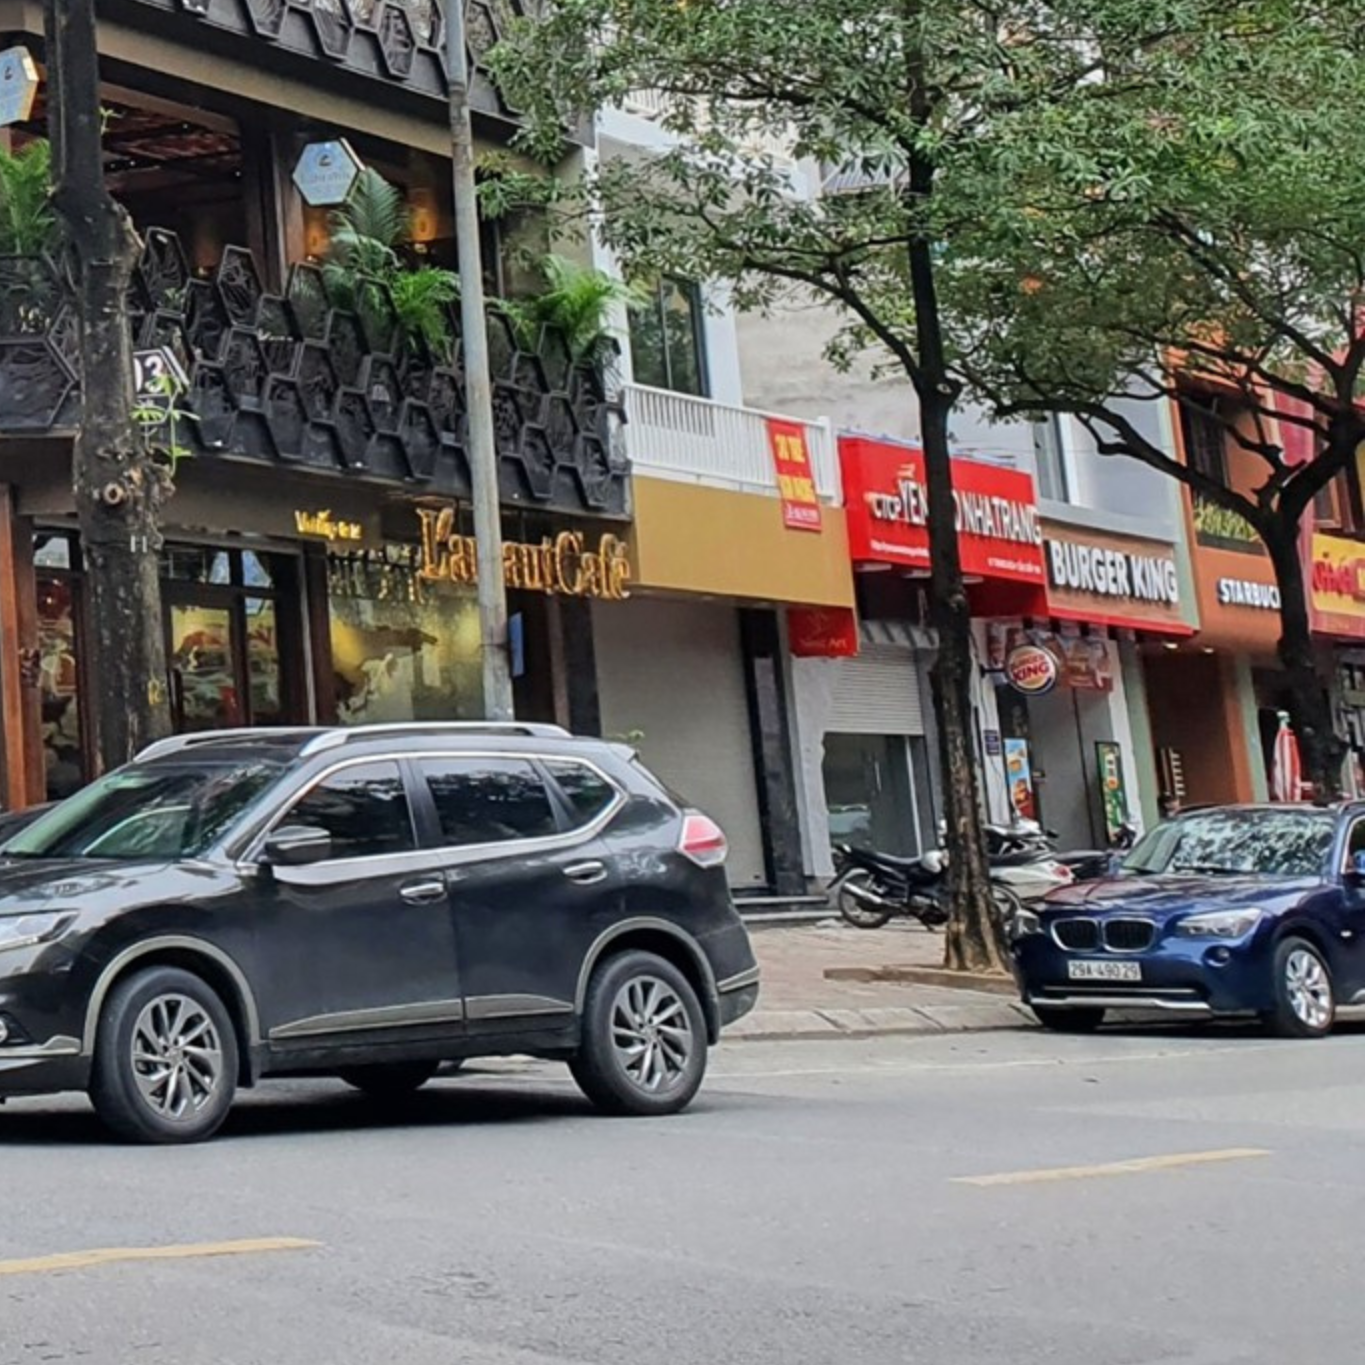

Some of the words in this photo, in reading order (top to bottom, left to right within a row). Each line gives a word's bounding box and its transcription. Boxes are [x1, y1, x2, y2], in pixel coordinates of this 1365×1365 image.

[416, 507, 554, 595] L'aant
[556, 530, 631, 599] Café
[1049, 540, 1131, 598] BURGER
[1131, 554, 1179, 603] KING
[1220, 577, 1282, 609] STARBUC
[1012, 661, 1049, 682] KING
